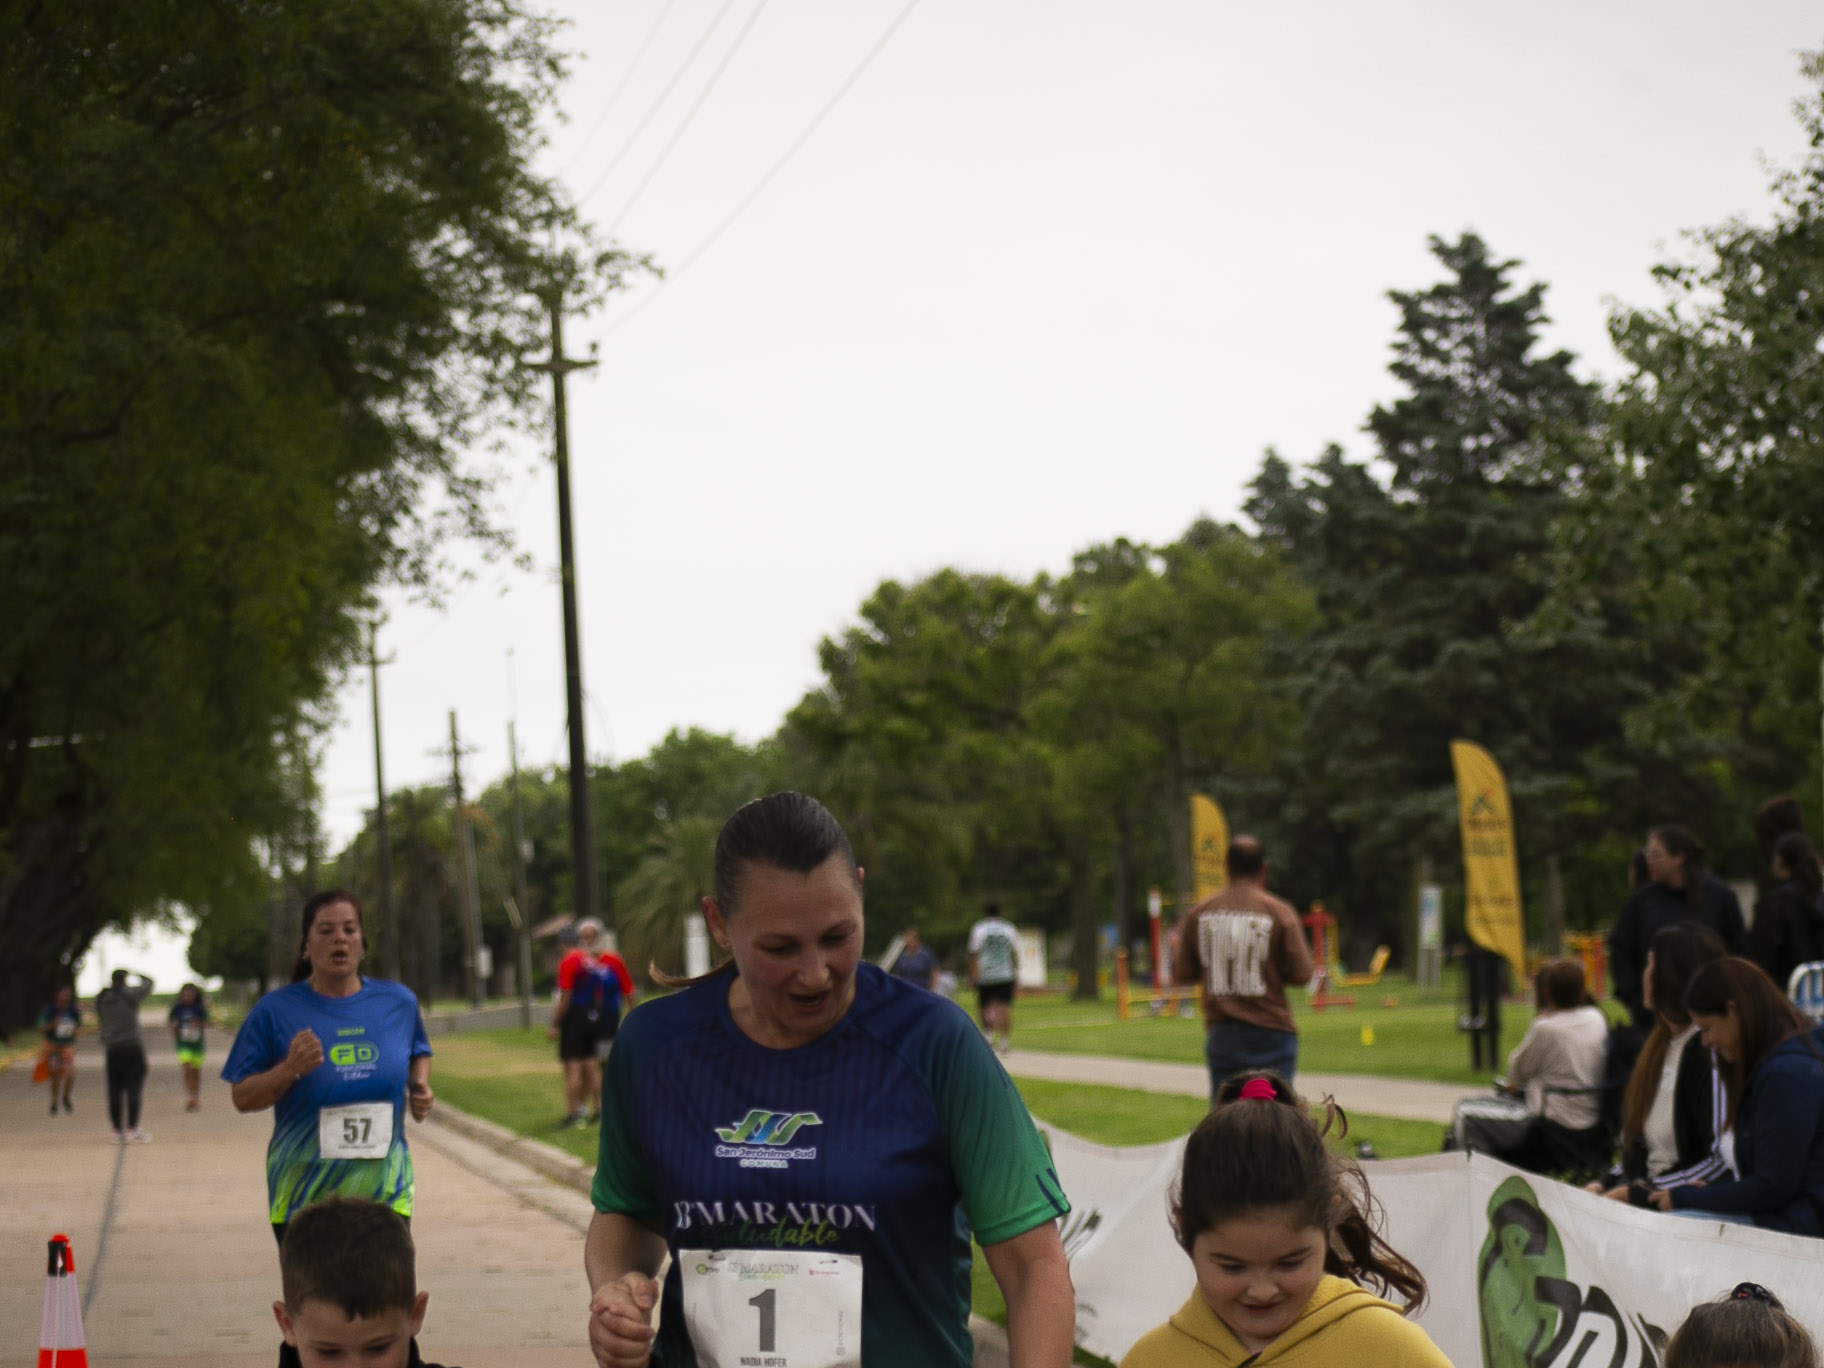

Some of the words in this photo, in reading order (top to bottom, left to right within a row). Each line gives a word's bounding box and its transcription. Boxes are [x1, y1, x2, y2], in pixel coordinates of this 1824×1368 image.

[343, 1117, 372, 1144] 57
[716, 1145, 738, 1158] San
[739, 1147, 791, 1159] Jerónimo
[792, 1148, 816, 1160] Sud
[696, 1201, 876, 1231] MARATON
[749, 1289, 776, 1352] 1
